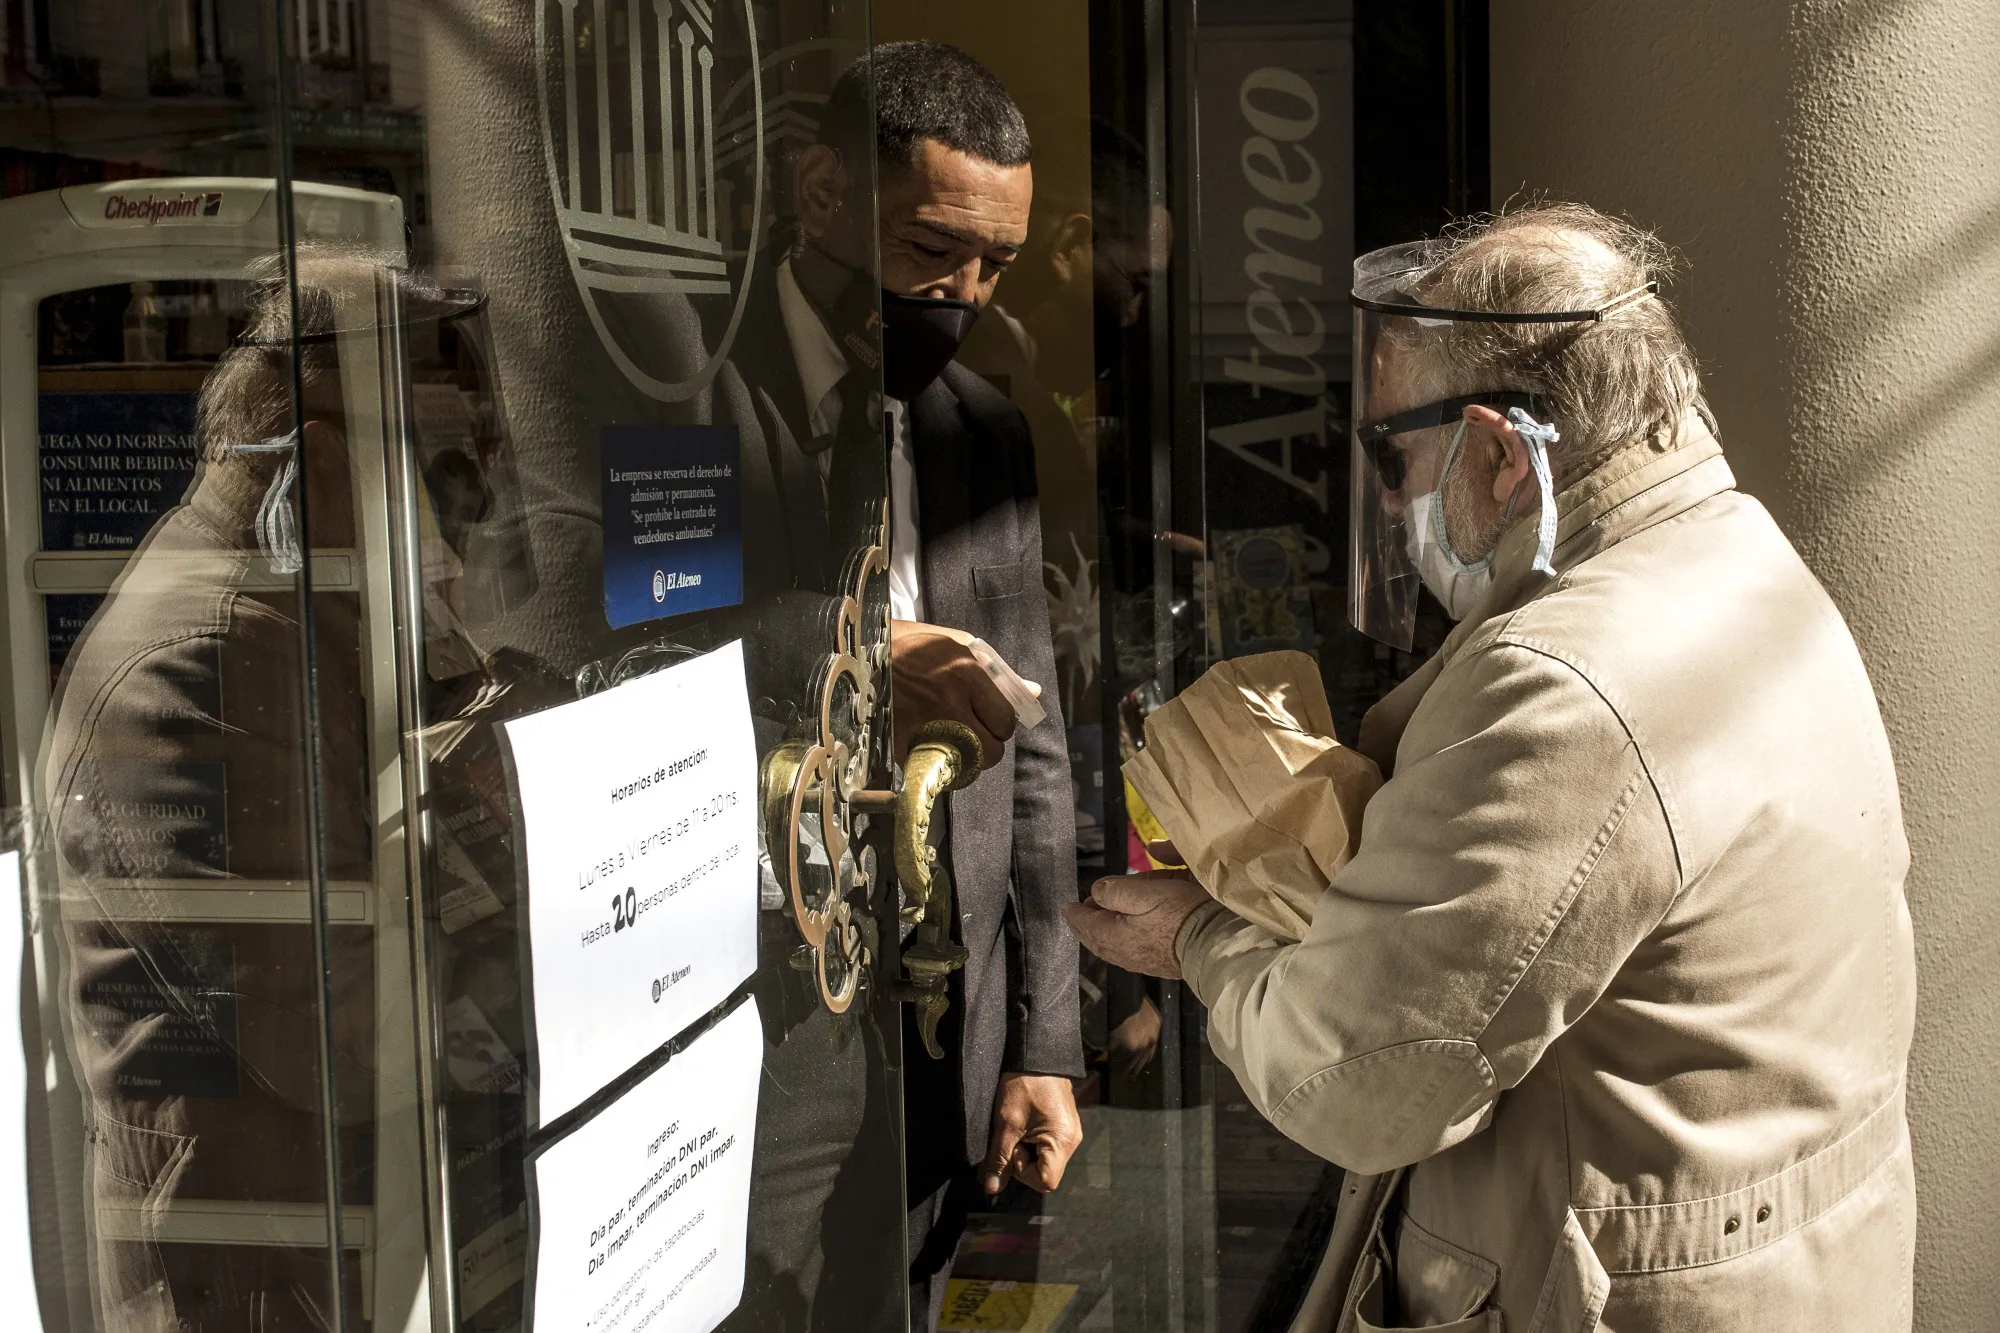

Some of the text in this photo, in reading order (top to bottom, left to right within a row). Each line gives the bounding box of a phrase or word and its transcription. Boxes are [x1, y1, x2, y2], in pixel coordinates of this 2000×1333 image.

[105, 192, 200, 223] Checkpoint
[1207, 66, 1329, 514] Ateneo
[39, 434, 199, 450] UEGA NO INGRESAR
[40, 456, 194, 471] ONSUMIR BEBIDAS
[610, 464, 732, 486] La empresa se reserva el derecho de
[43, 476, 162, 492] NI ALIMENTOS
[630, 485, 716, 504] admisión y permanencia.
[48, 498, 157, 513] EN EL LOCAL.
[673, 507, 680, 520] la
[681, 504, 707, 519] entrada
[708, 504, 716, 517] de
[88, 533, 133, 545] El Ateneo
[633, 529, 675, 545] vendedores
[667, 571, 702, 590] El Ateneo
[611, 748, 708, 804] Horarios de atención:
[579, 791, 739, 891] Lunes a Viernes de 11 a 20 hs.
[581, 921, 611, 948] Hasta
[612, 886, 637, 934] 20
[637, 881, 679, 918] personas
[680, 863, 707, 890] dentro
[709, 851, 721, 871] del
[662, 964, 691, 992] El Ateneo
[131, 1074, 162, 1087] Ateneo
[647, 1119, 680, 1158] Ingreso:
[590, 1126, 718, 1247] Día par, terminación DNI par.
[588, 1133, 736, 1276] Día impar, terminación DNI impar.
[593, 1209, 704, 1324] Uso obligatorio de tapabocas
[631, 1247, 716, 1333] distancia recomendada
[597, 1281, 647, 1333] ohol en gel
